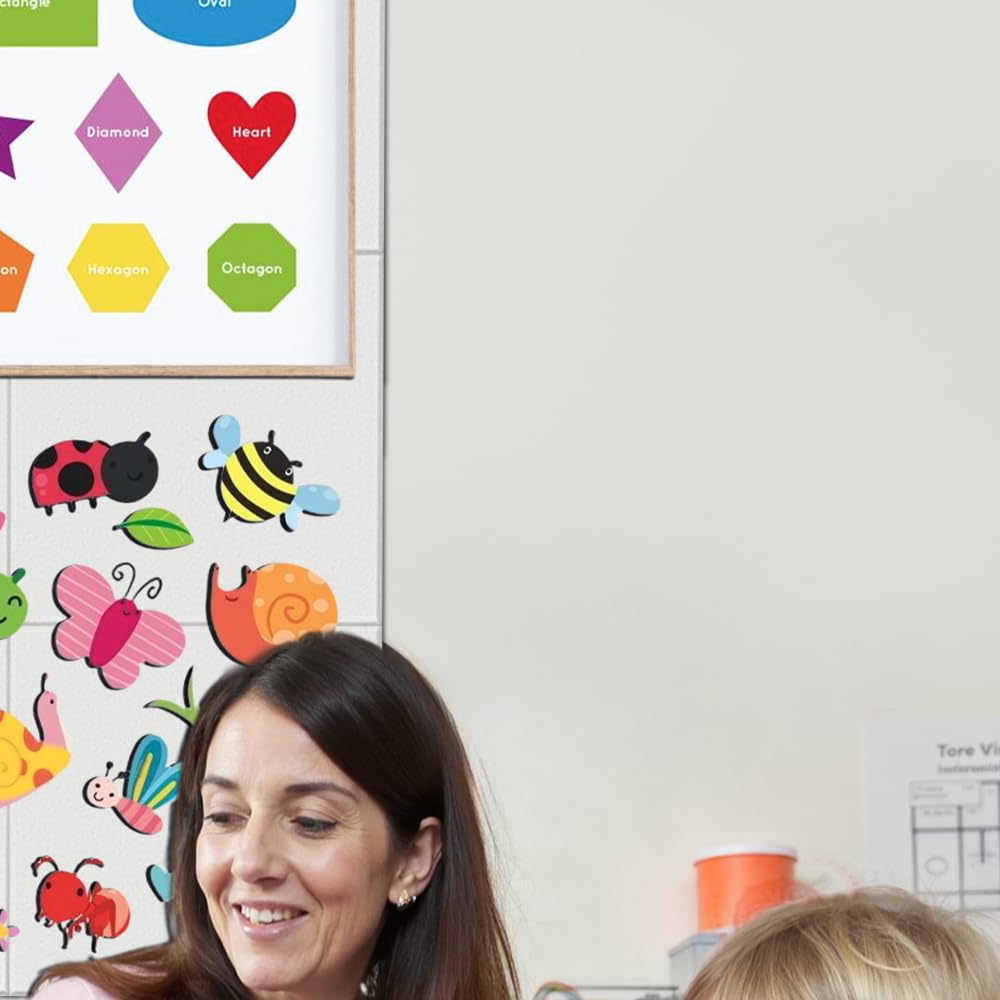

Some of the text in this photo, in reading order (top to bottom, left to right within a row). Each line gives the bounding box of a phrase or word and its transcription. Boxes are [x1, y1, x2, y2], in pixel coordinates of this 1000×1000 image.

[86, 126, 150, 138] Diamond
[232, 127, 271, 139] Heart
[87, 263, 149, 278] Hexagon
[221, 261, 282, 276] Octagon
